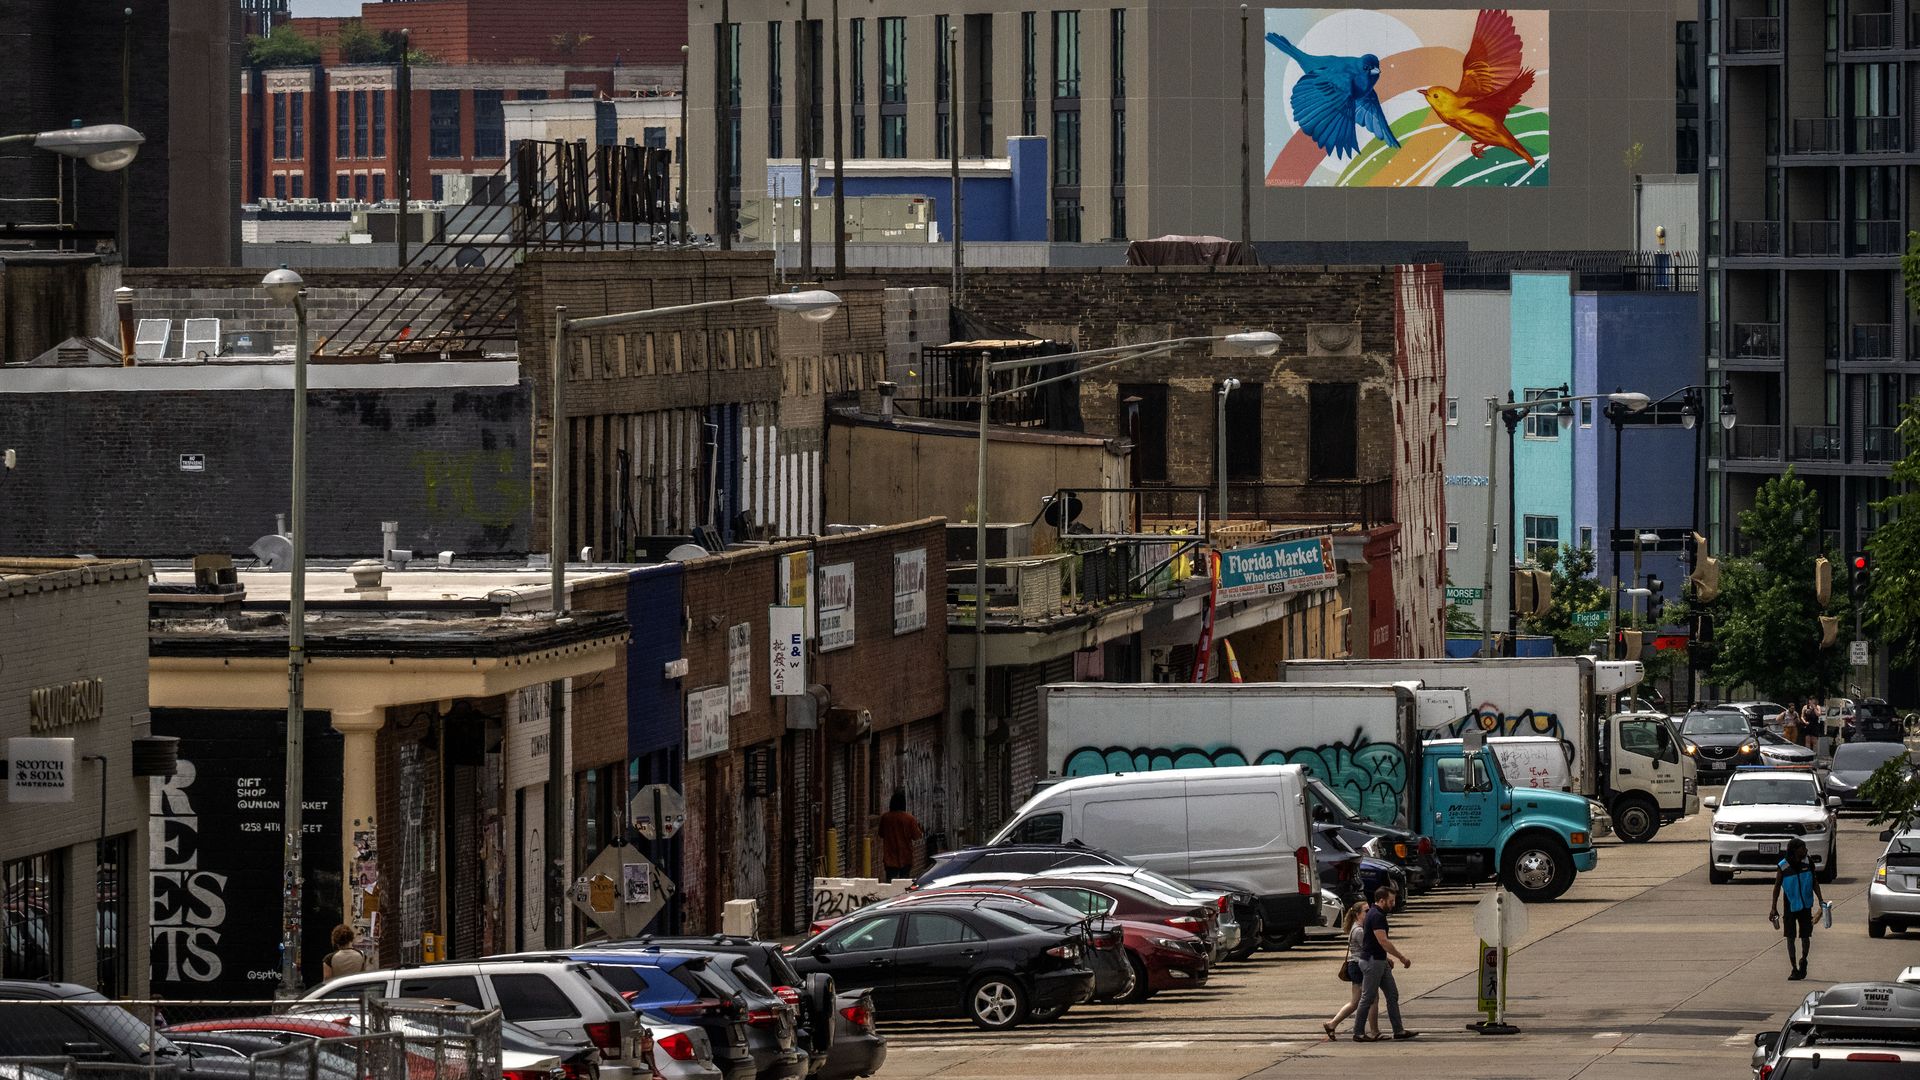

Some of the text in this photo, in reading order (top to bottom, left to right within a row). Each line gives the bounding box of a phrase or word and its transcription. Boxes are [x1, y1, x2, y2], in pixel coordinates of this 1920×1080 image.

[1229, 545, 1319, 574] Florida Market
[1243, 568, 1288, 583] Wholesale
[1289, 566, 1306, 578] Inc.
[1446, 589, 1474, 598] MORSE
[1577, 613, 1600, 622] Florida
[791, 633, 801, 644] E
[791, 646, 801, 657] &
[772, 639, 786, 693] 批發公司
[16, 760, 64, 770] SCOTCH
[30, 770, 64, 780] SODA
[237, 778, 262, 787] GIFT
[237, 788, 266, 797] SHOP
[237, 800, 328, 810] @UNION RKET
[264, 823, 281, 832] 4TH
[302, 824, 322, 832] EET
[150, 926, 223, 982] TS
[1864, 993, 1890, 1001] THULE
